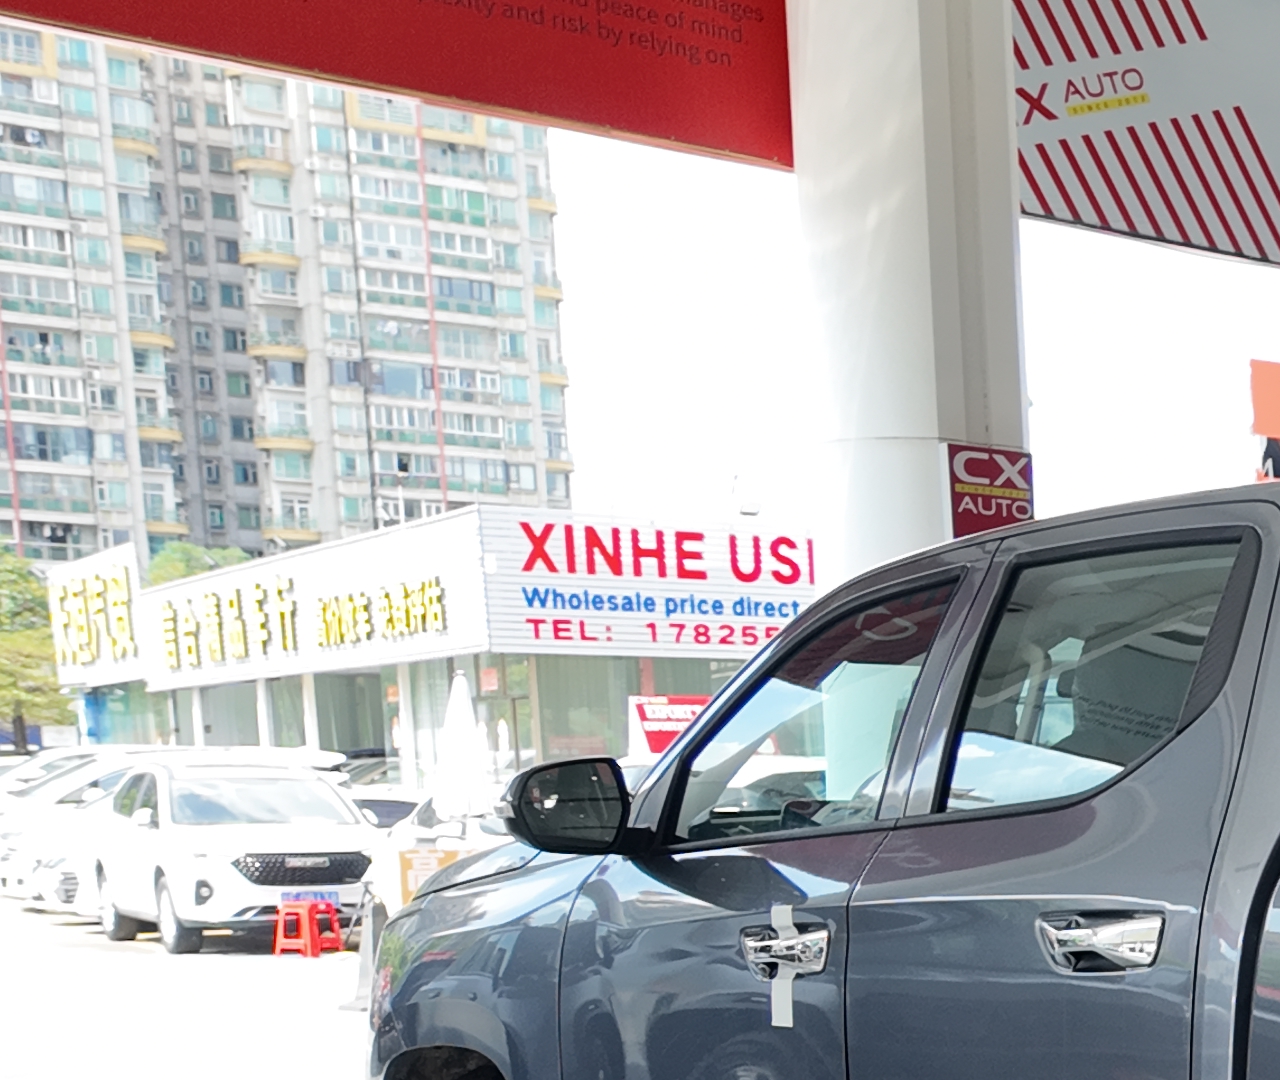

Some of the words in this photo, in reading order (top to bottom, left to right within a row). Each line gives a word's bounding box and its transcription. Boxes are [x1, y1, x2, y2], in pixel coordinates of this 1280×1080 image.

[502, 5, 545, 26] and
[552, 14, 591, 36] risk
[599, 22, 623, 48] by
[629, 31, 702, 65] relying
[705, 48, 732, 67] on
[664, 11, 684, 29] of
[1015, 81, 1060, 126] X
[1064, 68, 1144, 104] AUTO
[952, 450, 1030, 490] CX
[957, 495, 1032, 520] AUTO
[518, 521, 708, 581] XINHE
[728, 532, 815, 586] US
[521, 585, 658, 614] Wholesale
[664, 593, 725, 619] price
[731, 595, 802, 620] direct
[525, 618, 614, 643] TEL:
